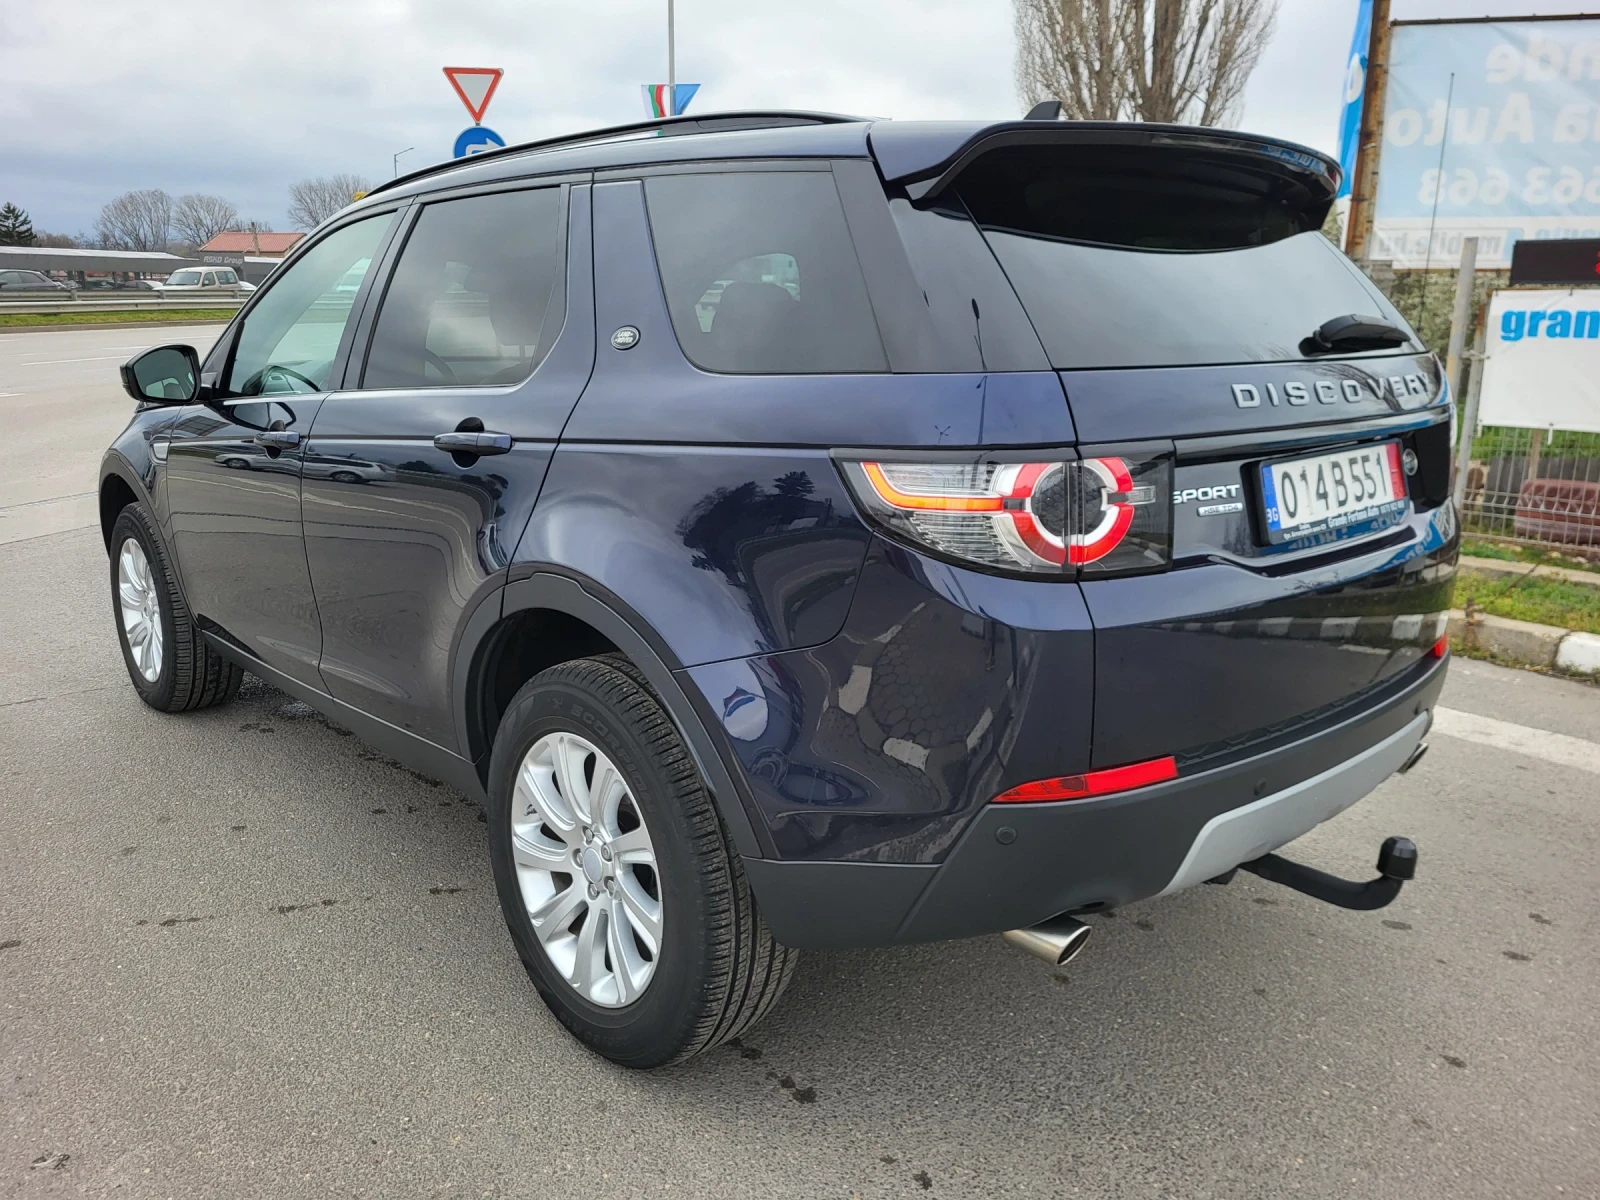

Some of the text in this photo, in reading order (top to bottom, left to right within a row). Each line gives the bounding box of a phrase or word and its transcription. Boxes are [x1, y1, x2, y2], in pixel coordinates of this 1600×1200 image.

[1500, 310, 1600, 342] gran
[1232, 373, 1429, 408] DISCOVERY
[1172, 484, 1240, 504] SPORT
[1281, 452, 1388, 518] 014B551
[1203, 506, 1220, 514] HSE
